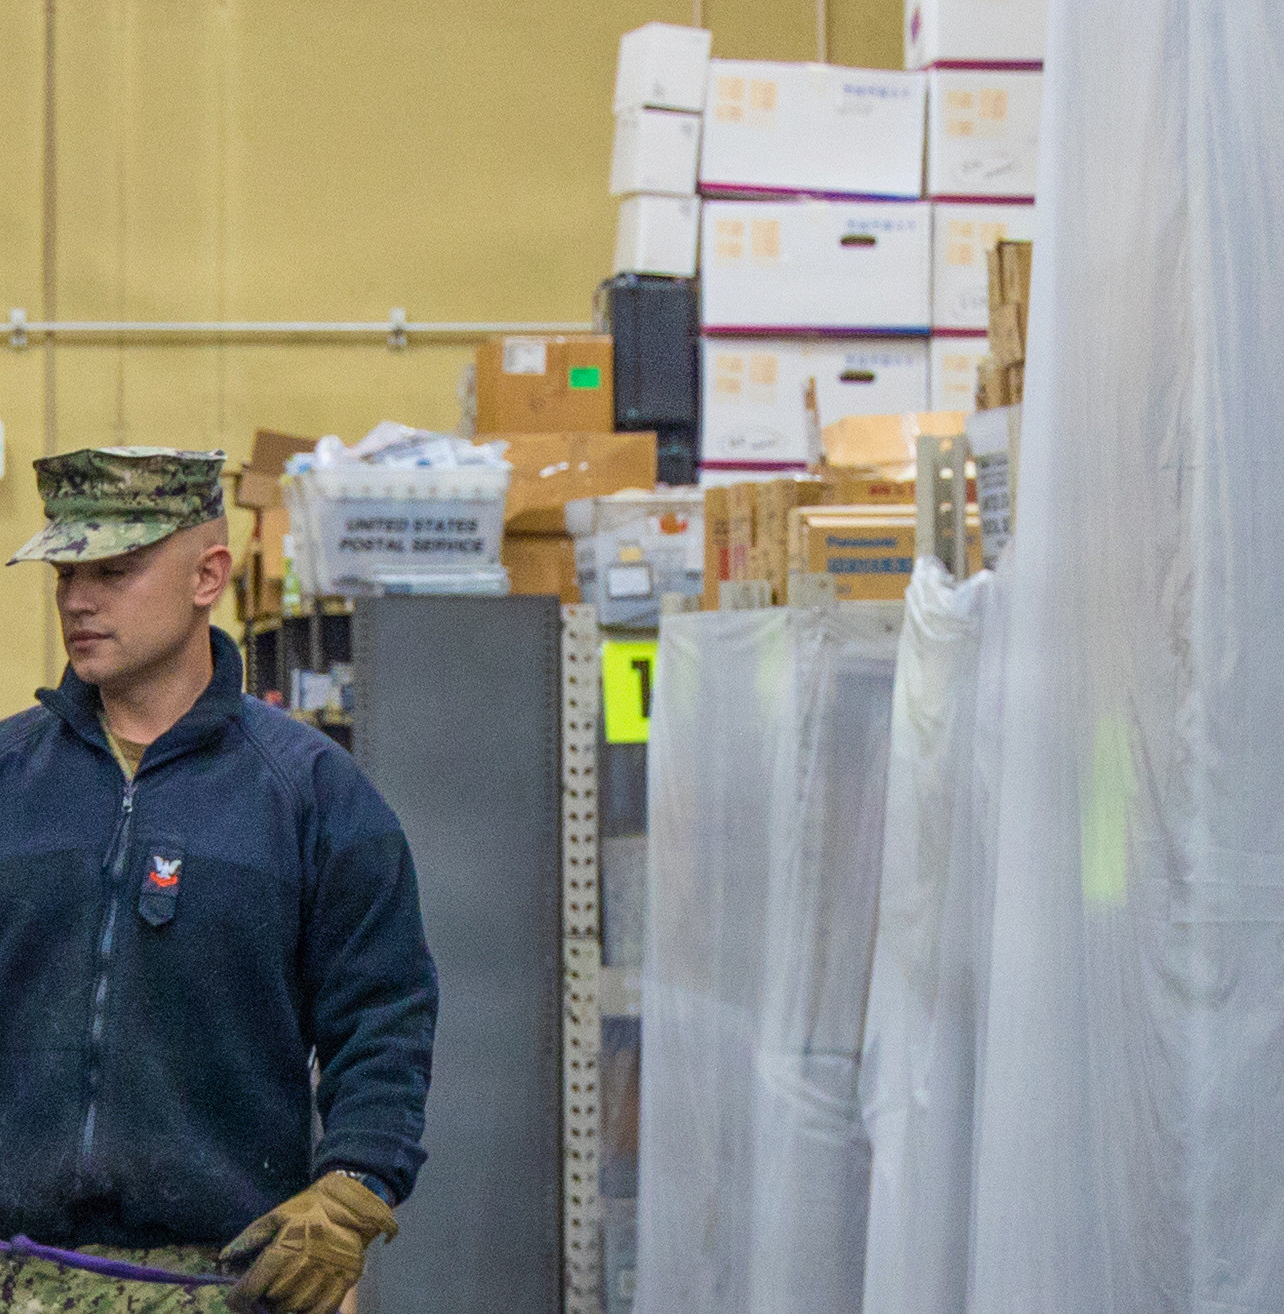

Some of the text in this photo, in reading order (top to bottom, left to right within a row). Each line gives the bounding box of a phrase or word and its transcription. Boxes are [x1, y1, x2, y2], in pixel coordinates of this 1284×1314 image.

[345, 517, 479, 533] UNITED STATES
[339, 537, 484, 553] POSTAL SERVICE
[631, 660, 651, 718] 1
